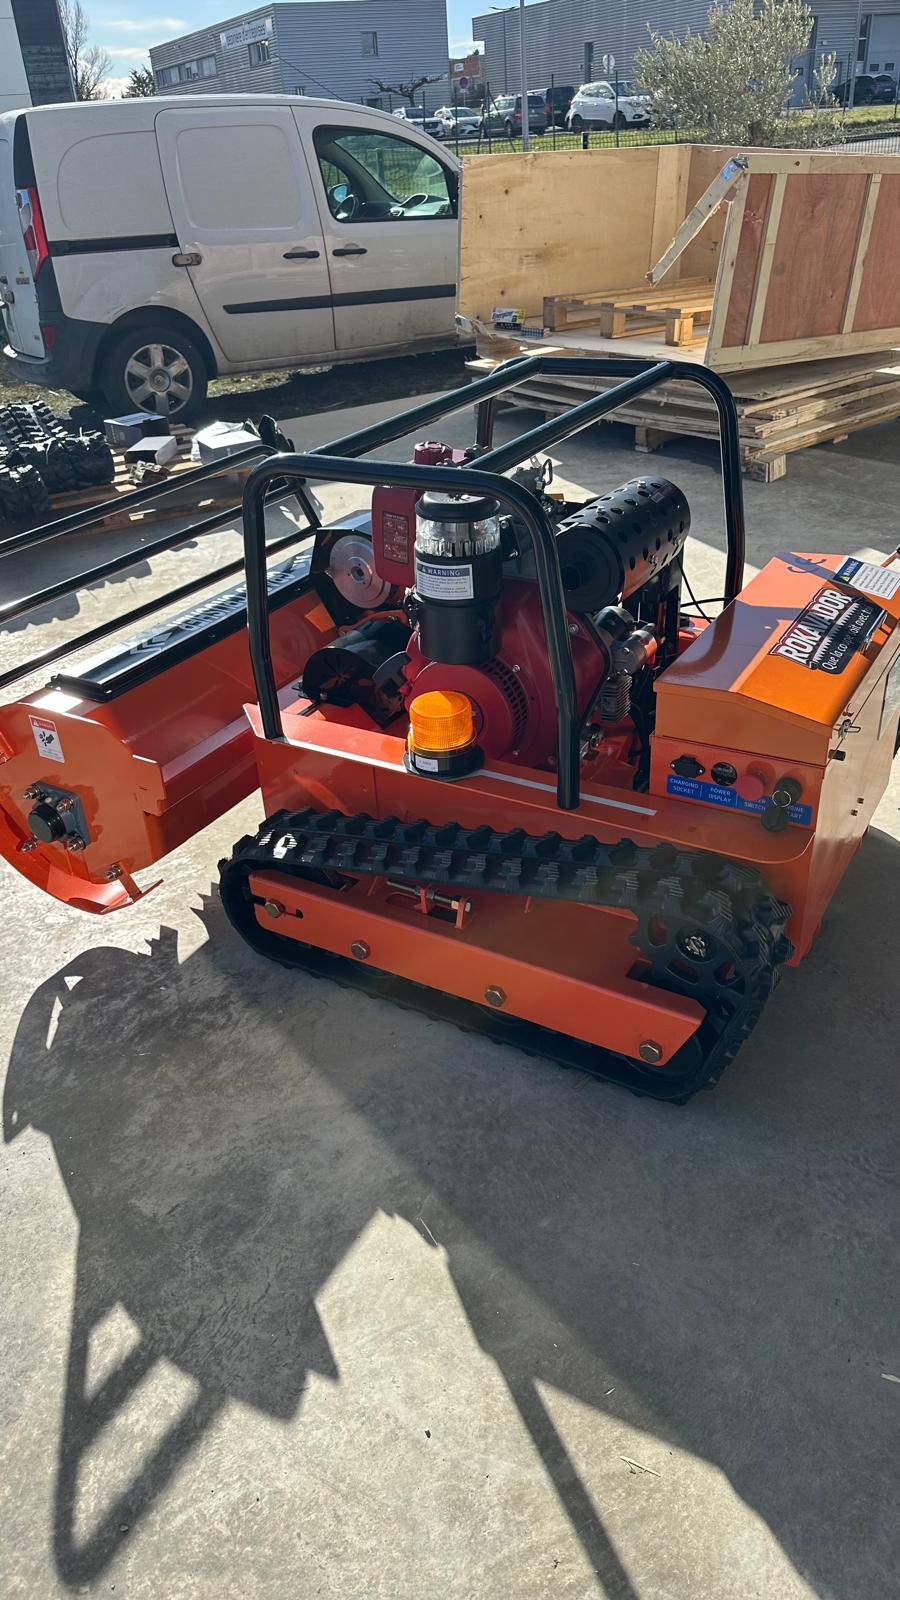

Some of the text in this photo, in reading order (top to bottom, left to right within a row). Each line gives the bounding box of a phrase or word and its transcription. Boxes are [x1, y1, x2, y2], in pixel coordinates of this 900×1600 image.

[427, 568, 460, 576] WARNING
[778, 591, 852, 664] ROKAVADOR
[822, 654, 840, 670] Que
[856, 612, 870, 626] avec
[670, 778, 699, 789] CHARGING
[673, 786, 694, 795] SOCKET
[710, 787, 731, 796] POWER
[708, 793, 731, 803] DISPLAY
[744, 801, 766, 811] SWITCH
